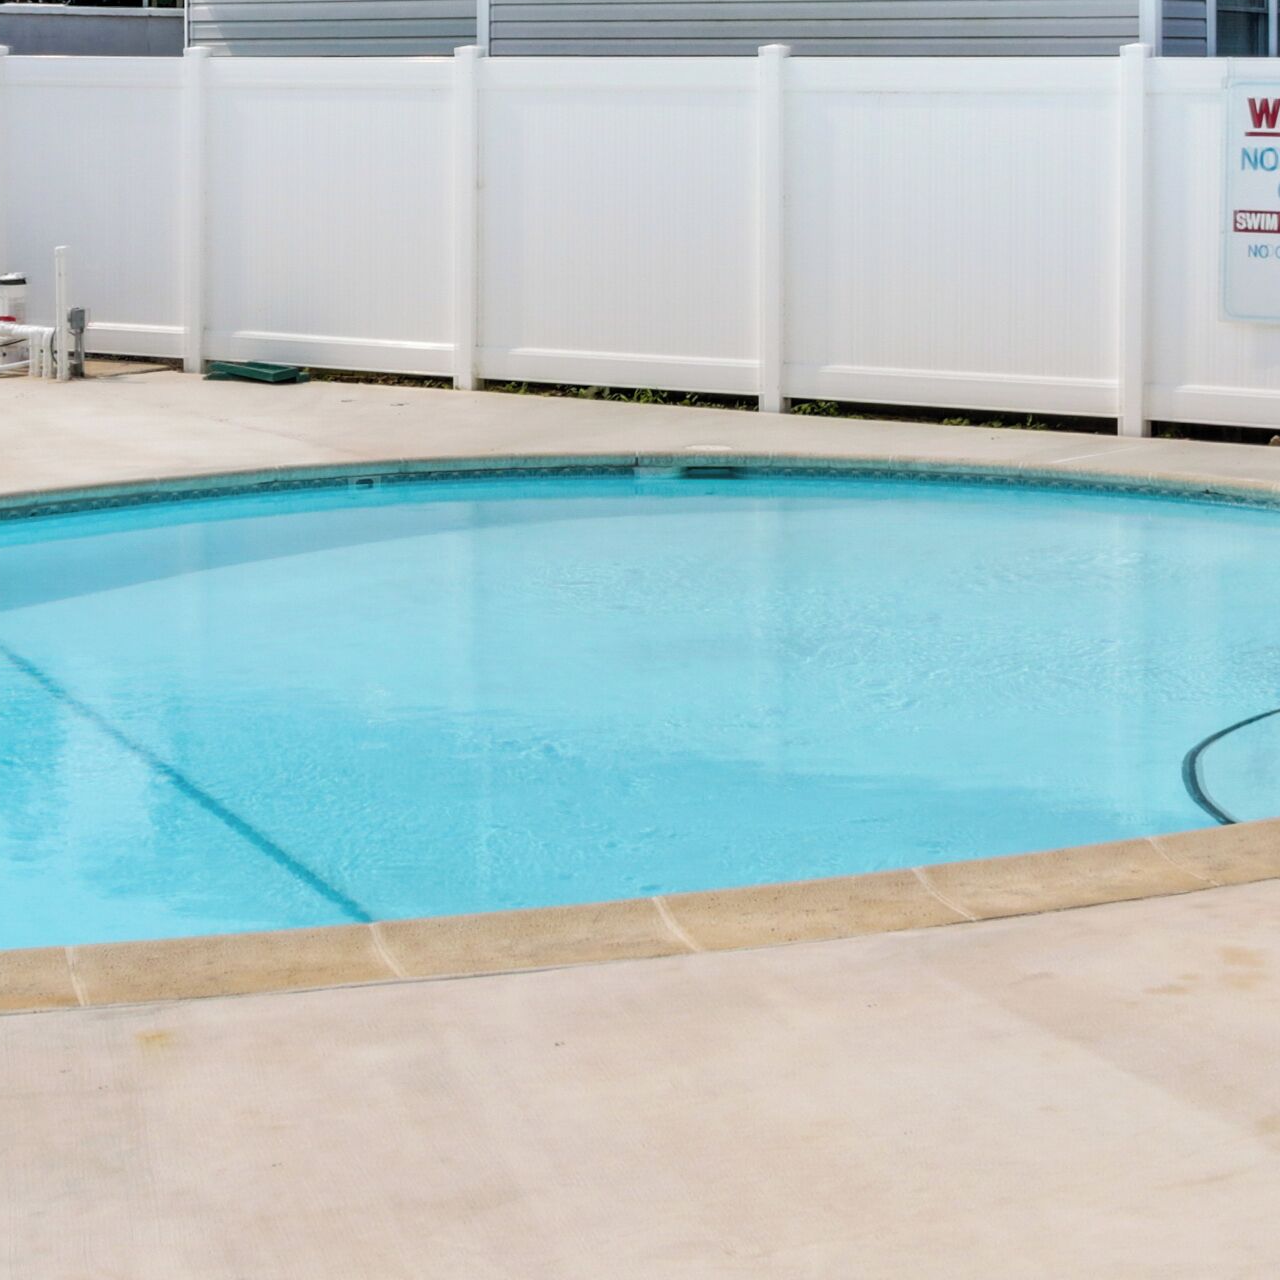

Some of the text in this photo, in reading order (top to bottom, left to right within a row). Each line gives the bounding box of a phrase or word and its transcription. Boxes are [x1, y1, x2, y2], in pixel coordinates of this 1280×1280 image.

[1241, 147, 1279, 171] NO
[1235, 212, 1279, 232] SWIM
[1247, 245, 1269, 259] NO
